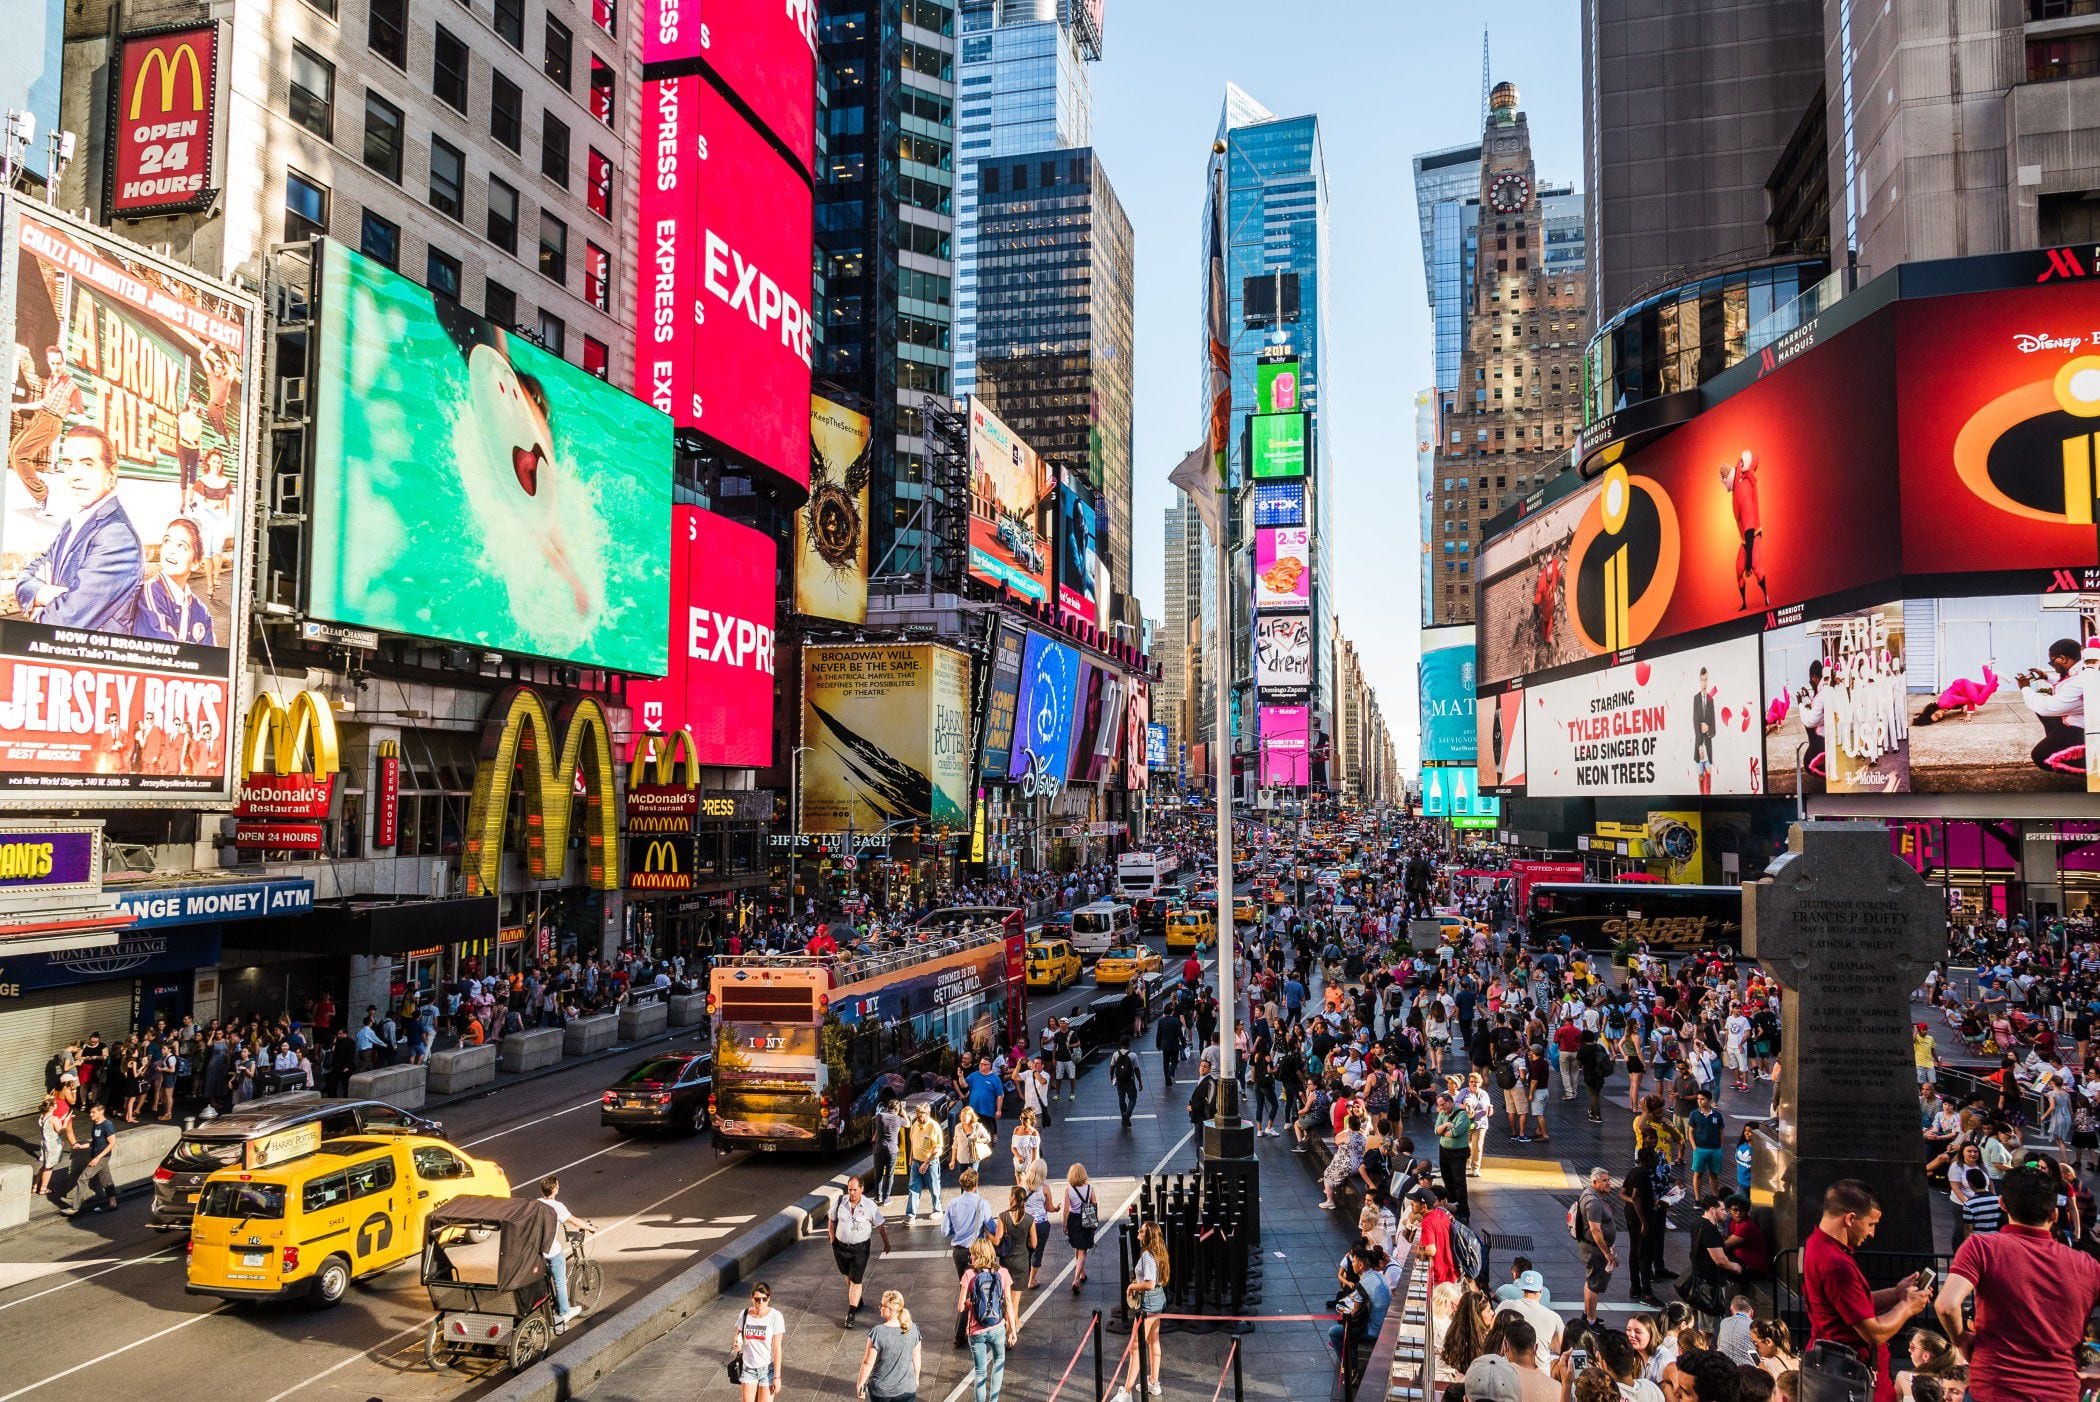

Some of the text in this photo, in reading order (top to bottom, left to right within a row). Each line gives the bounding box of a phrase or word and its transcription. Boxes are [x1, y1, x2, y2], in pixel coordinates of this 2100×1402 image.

[134, 119, 198, 143] OPEN
[139, 142, 189, 174] 24
[123, 174, 203, 199] HOURS
[21, 224, 66, 268] CHAZZ
[147, 291, 186, 324] JOINS
[187, 306, 209, 335] THE
[654, 219, 676, 343] EXPRESS
[1778, 318, 1820, 351] MARRIOTT
[2013, 333, 2081, 353] Disney
[71, 287, 182, 416] A BRONX
[1778, 334, 1814, 362] MARQUIS
[92, 373, 158, 466] TALE
[1583, 415, 1617, 439] MARRIOTT
[1583, 430, 1612, 451] MARQUIS
[1277, 532, 1287, 545] 2
[1777, 603, 1804, 617] MARRIOTT
[1778, 613, 1802, 625] MARQUIS
[55, 630, 180, 655] NOW ON BROADWAY
[1839, 612, 1885, 654] ARE
[887, 650, 914, 659] WILL
[811, 660, 922, 672] NEVER BE THE SAME.
[825, 673, 866, 681] THEATRICAL
[867, 672, 895, 680] MARVEL
[897, 671, 915, 679] THAT
[870, 680, 915, 688] POSSIBILITIES
[0, 664, 222, 741] JERSEY BOYS
[1590, 690, 1635, 714] STARRING
[936, 704, 965, 733] HARRY
[1567, 705, 1666, 742] TYLER GLENN
[935, 728, 966, 755] POTTER
[1574, 736, 1657, 763] LEAD SINGER OF
[7, 748, 82, 762] BEST MUSICAL
[1576, 761, 1656, 786] NEON TREES
[239, 786, 327, 802] McDonald's
[628, 792, 695, 804] McDonald's
[249, 803, 310, 814] Restaurant
[638, 804, 684, 812] Restaurant
[386, 803, 394, 842] HOURS
[237, 831, 318, 842] OPEN 24 HOURS
[187, 889, 310, 916] MONEY ATM
[679, 901, 700, 911] EXPRESS
[1602, 915, 1708, 934] GOLDEN
[1792, 912, 1910, 925] FRANCIS DUFFY
[49, 939, 168, 962] MONEY EXCHANGE
[1808, 940, 1895, 950] CATHOLIC PRIEST
[937, 965, 977, 986] SUMMER IS FOR
[933, 975, 982, 1003] GETTING WILD.
[766, 1037, 786, 1048] NY
[271, 1131, 318, 1153] HARRY POTTER
[248, 1236, 262, 1245] 745
